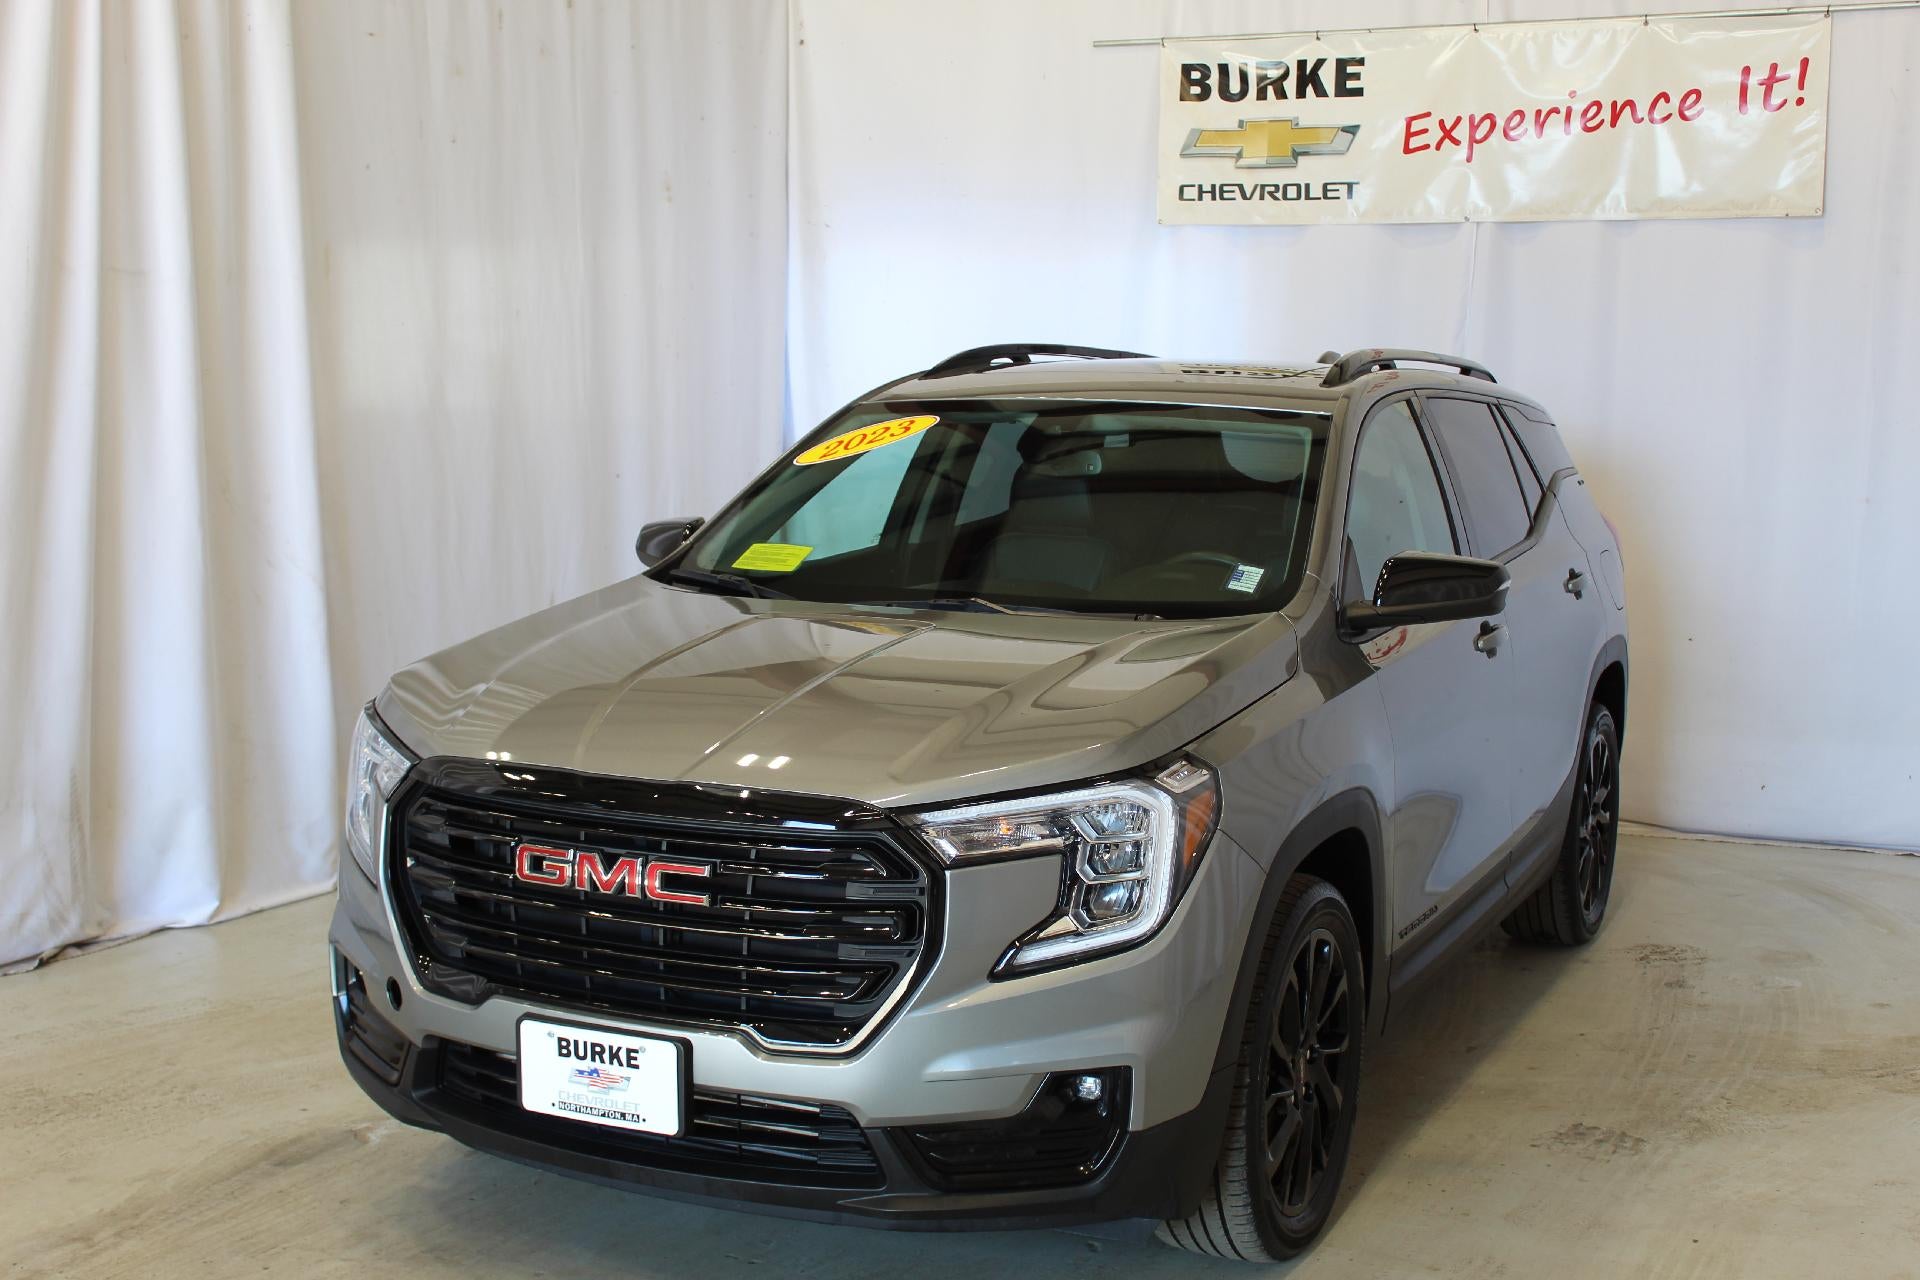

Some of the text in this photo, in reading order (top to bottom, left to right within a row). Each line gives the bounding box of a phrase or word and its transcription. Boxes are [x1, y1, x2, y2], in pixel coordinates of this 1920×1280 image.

[1179, 57, 1365, 103] BURKE
[1402, 56, 1811, 163] Experience It!
[1178, 181, 1360, 202] CHEVROLET
[818, 419, 916, 459] 2023
[515, 843, 712, 907] GMC
[557, 1036, 640, 1070] BURKE
[558, 1090, 640, 1112] CHEVROLET
[625, 1112, 640, 1123] MA
